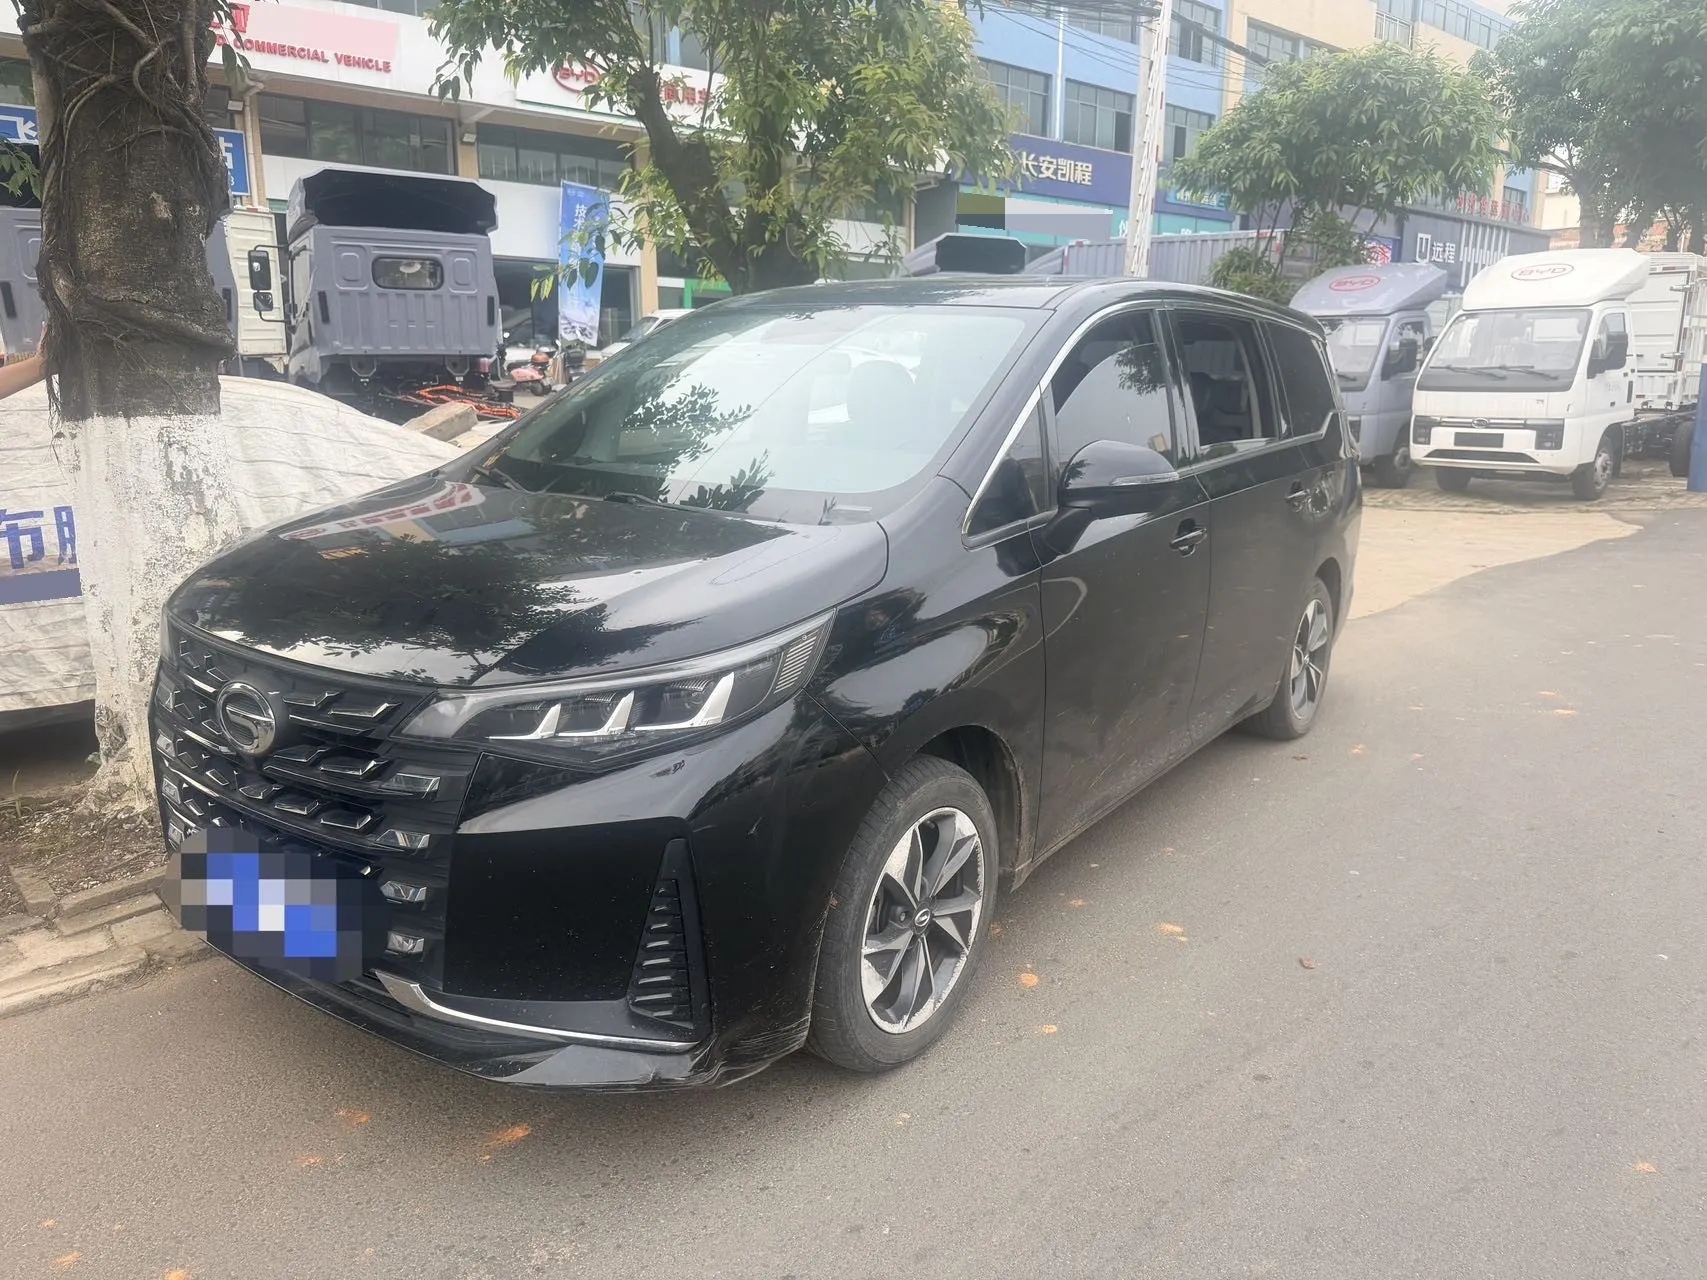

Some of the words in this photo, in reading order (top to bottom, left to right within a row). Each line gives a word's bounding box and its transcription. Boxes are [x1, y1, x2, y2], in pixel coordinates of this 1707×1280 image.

[233, 38, 330, 64] COMMERCIAL
[334, 52, 392, 73] VEHICLE
[1020, 151, 1093, 186] 长安凯程
[1431, 241, 1456, 264] 远程
